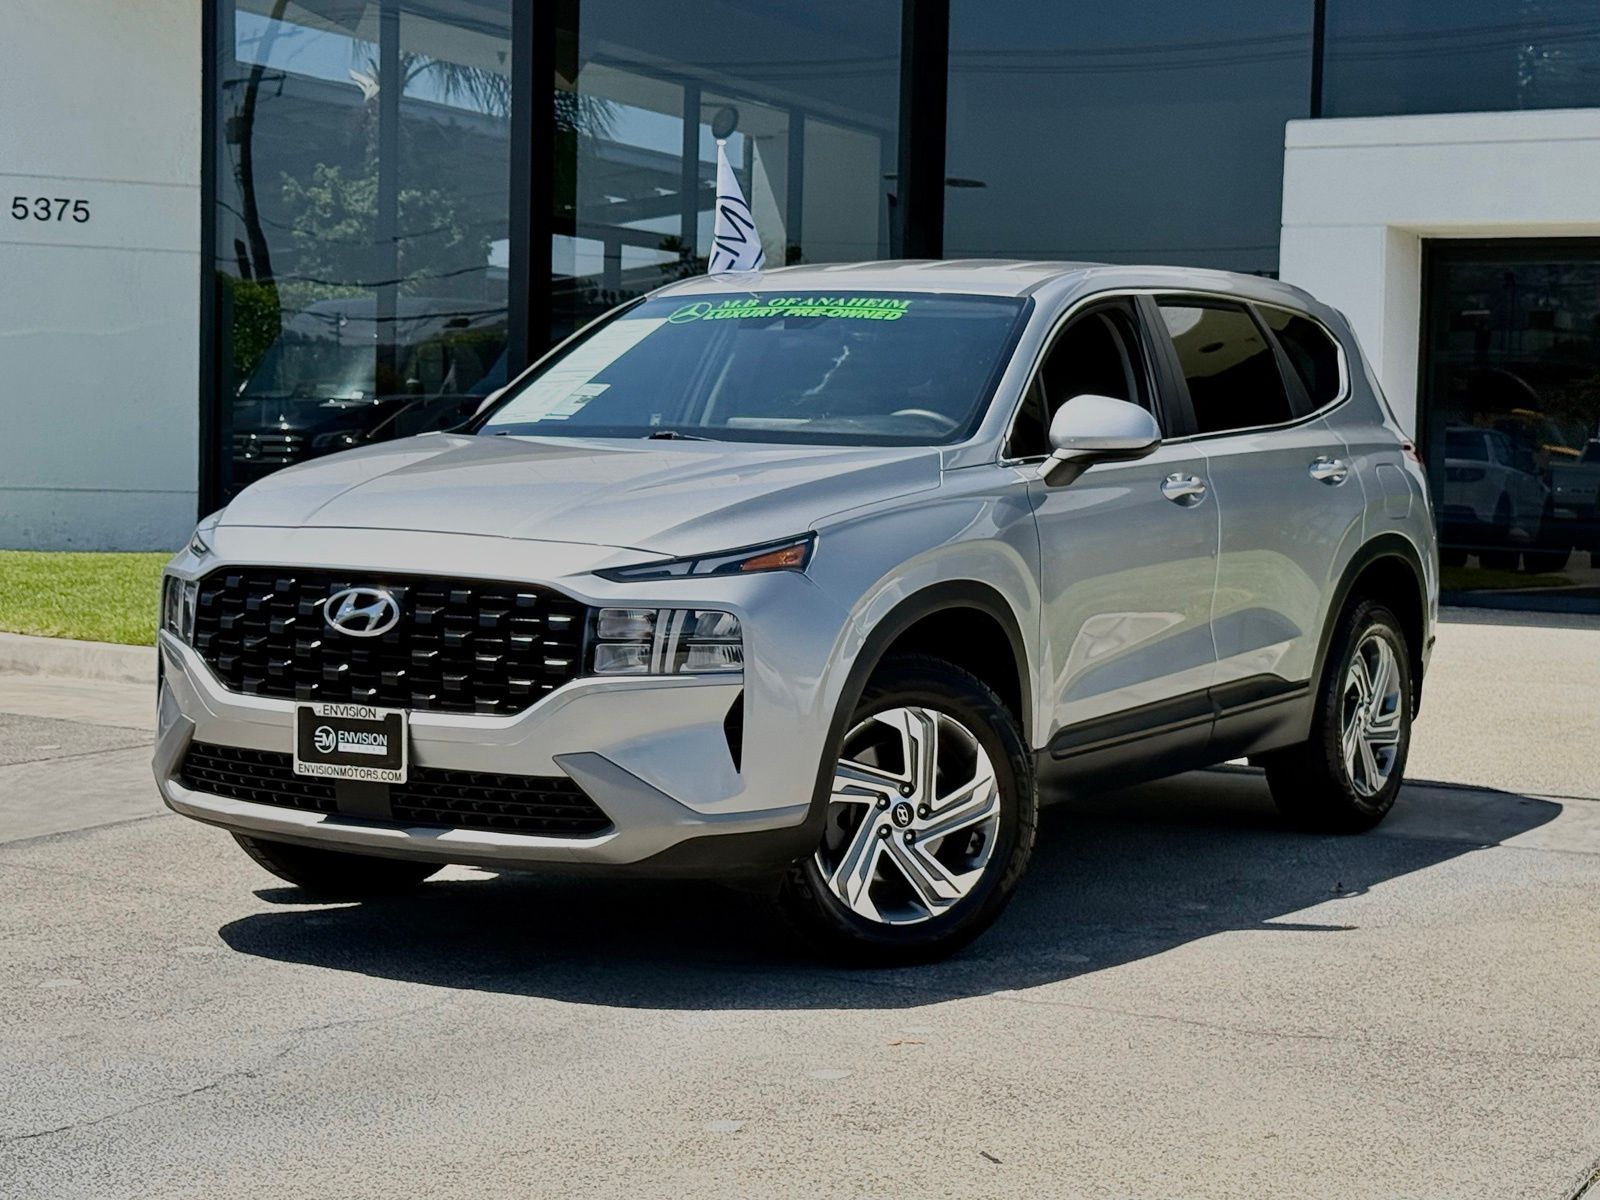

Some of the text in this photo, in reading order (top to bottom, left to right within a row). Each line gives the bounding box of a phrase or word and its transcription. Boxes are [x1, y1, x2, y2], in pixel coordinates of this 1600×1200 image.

[11, 196, 91, 223] 5375
[799, 297, 913, 309] ANAHEIM
[702, 308, 904, 321] LUXURY PRE-OWNED
[322, 704, 377, 719] ENVISION
[337, 730, 388, 746] ENVISION
[298, 763, 402, 782] ENVISIONMOTORS.COM
